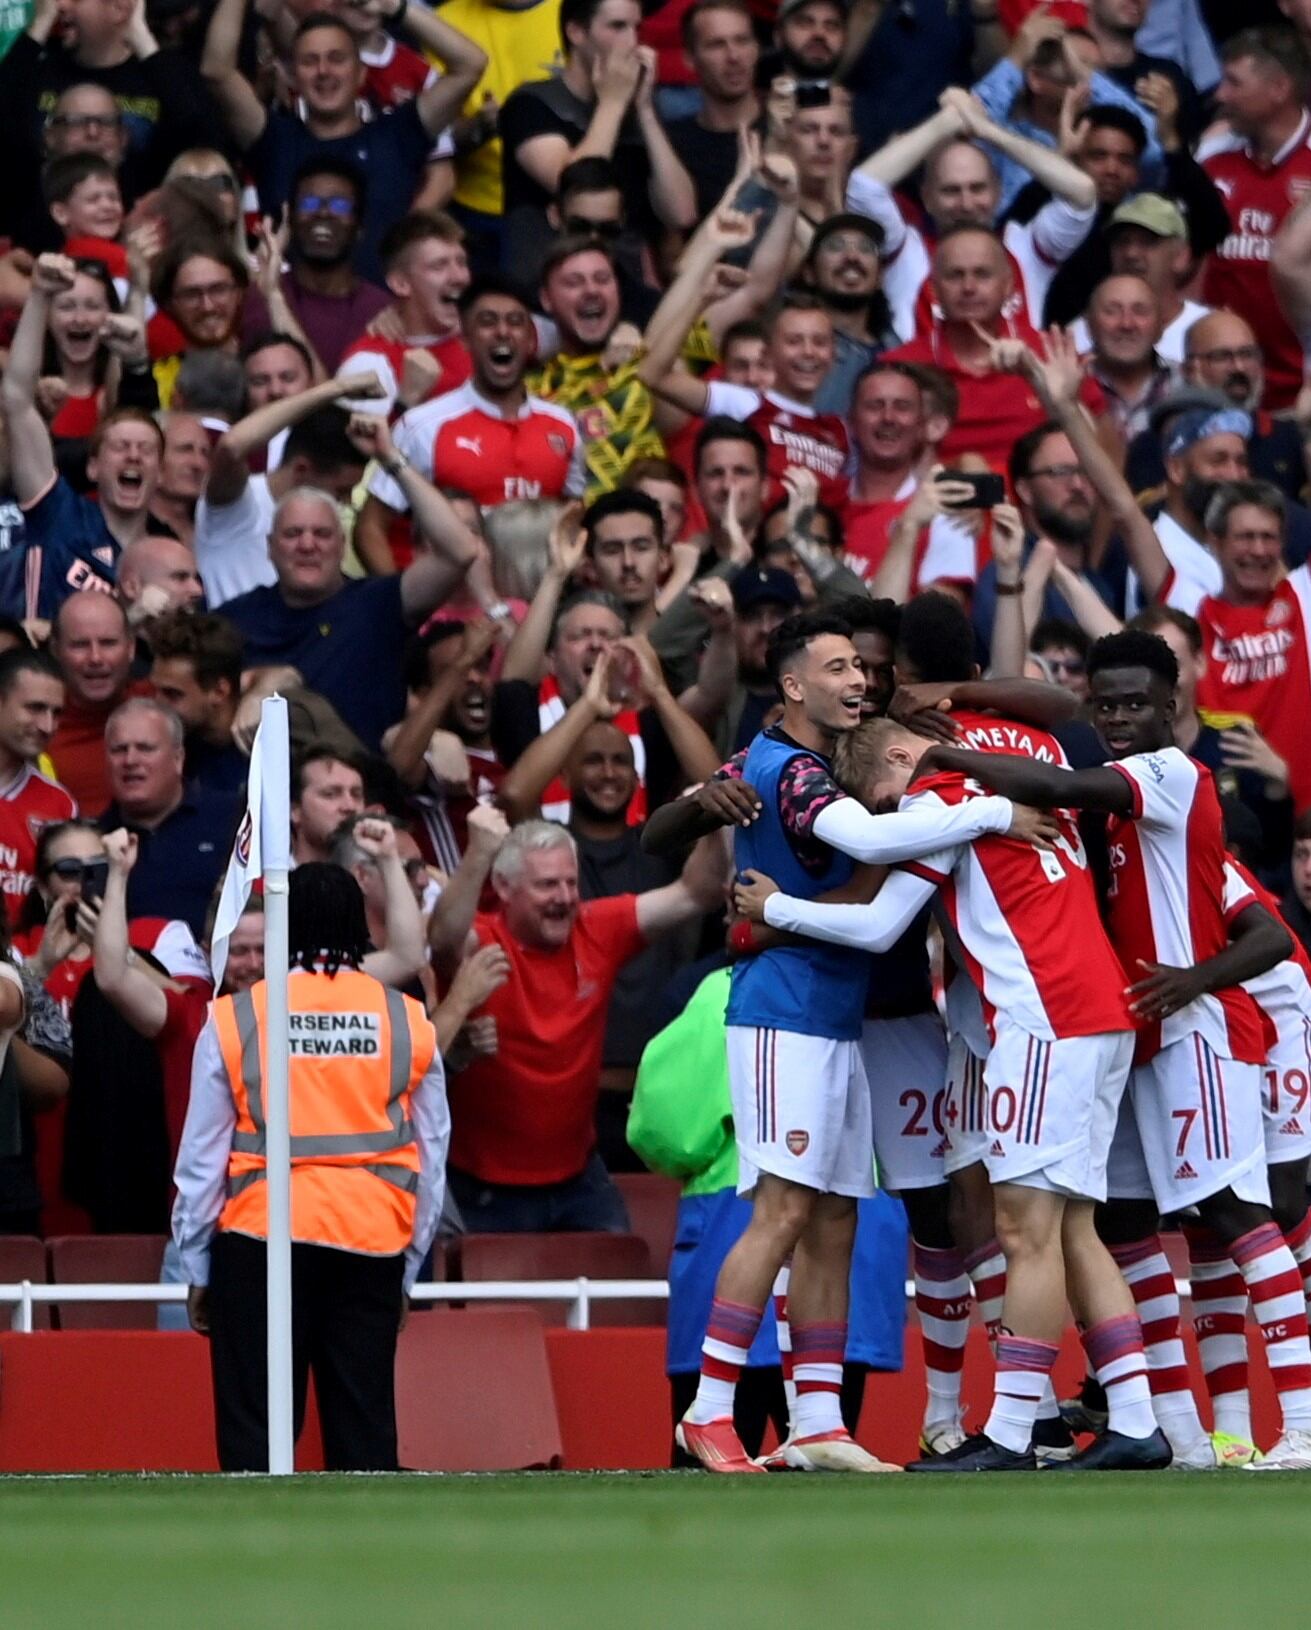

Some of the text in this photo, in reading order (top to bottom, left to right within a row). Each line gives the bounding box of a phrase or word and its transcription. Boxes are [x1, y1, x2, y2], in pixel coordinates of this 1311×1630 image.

[289, 1014, 376, 1031] RSENAL
[288, 1038, 378, 1054] TEWARD
[991, 1086, 1016, 1133] 0
[1265, 1069, 1308, 1114] 19
[1172, 1109, 1198, 1157] 7
